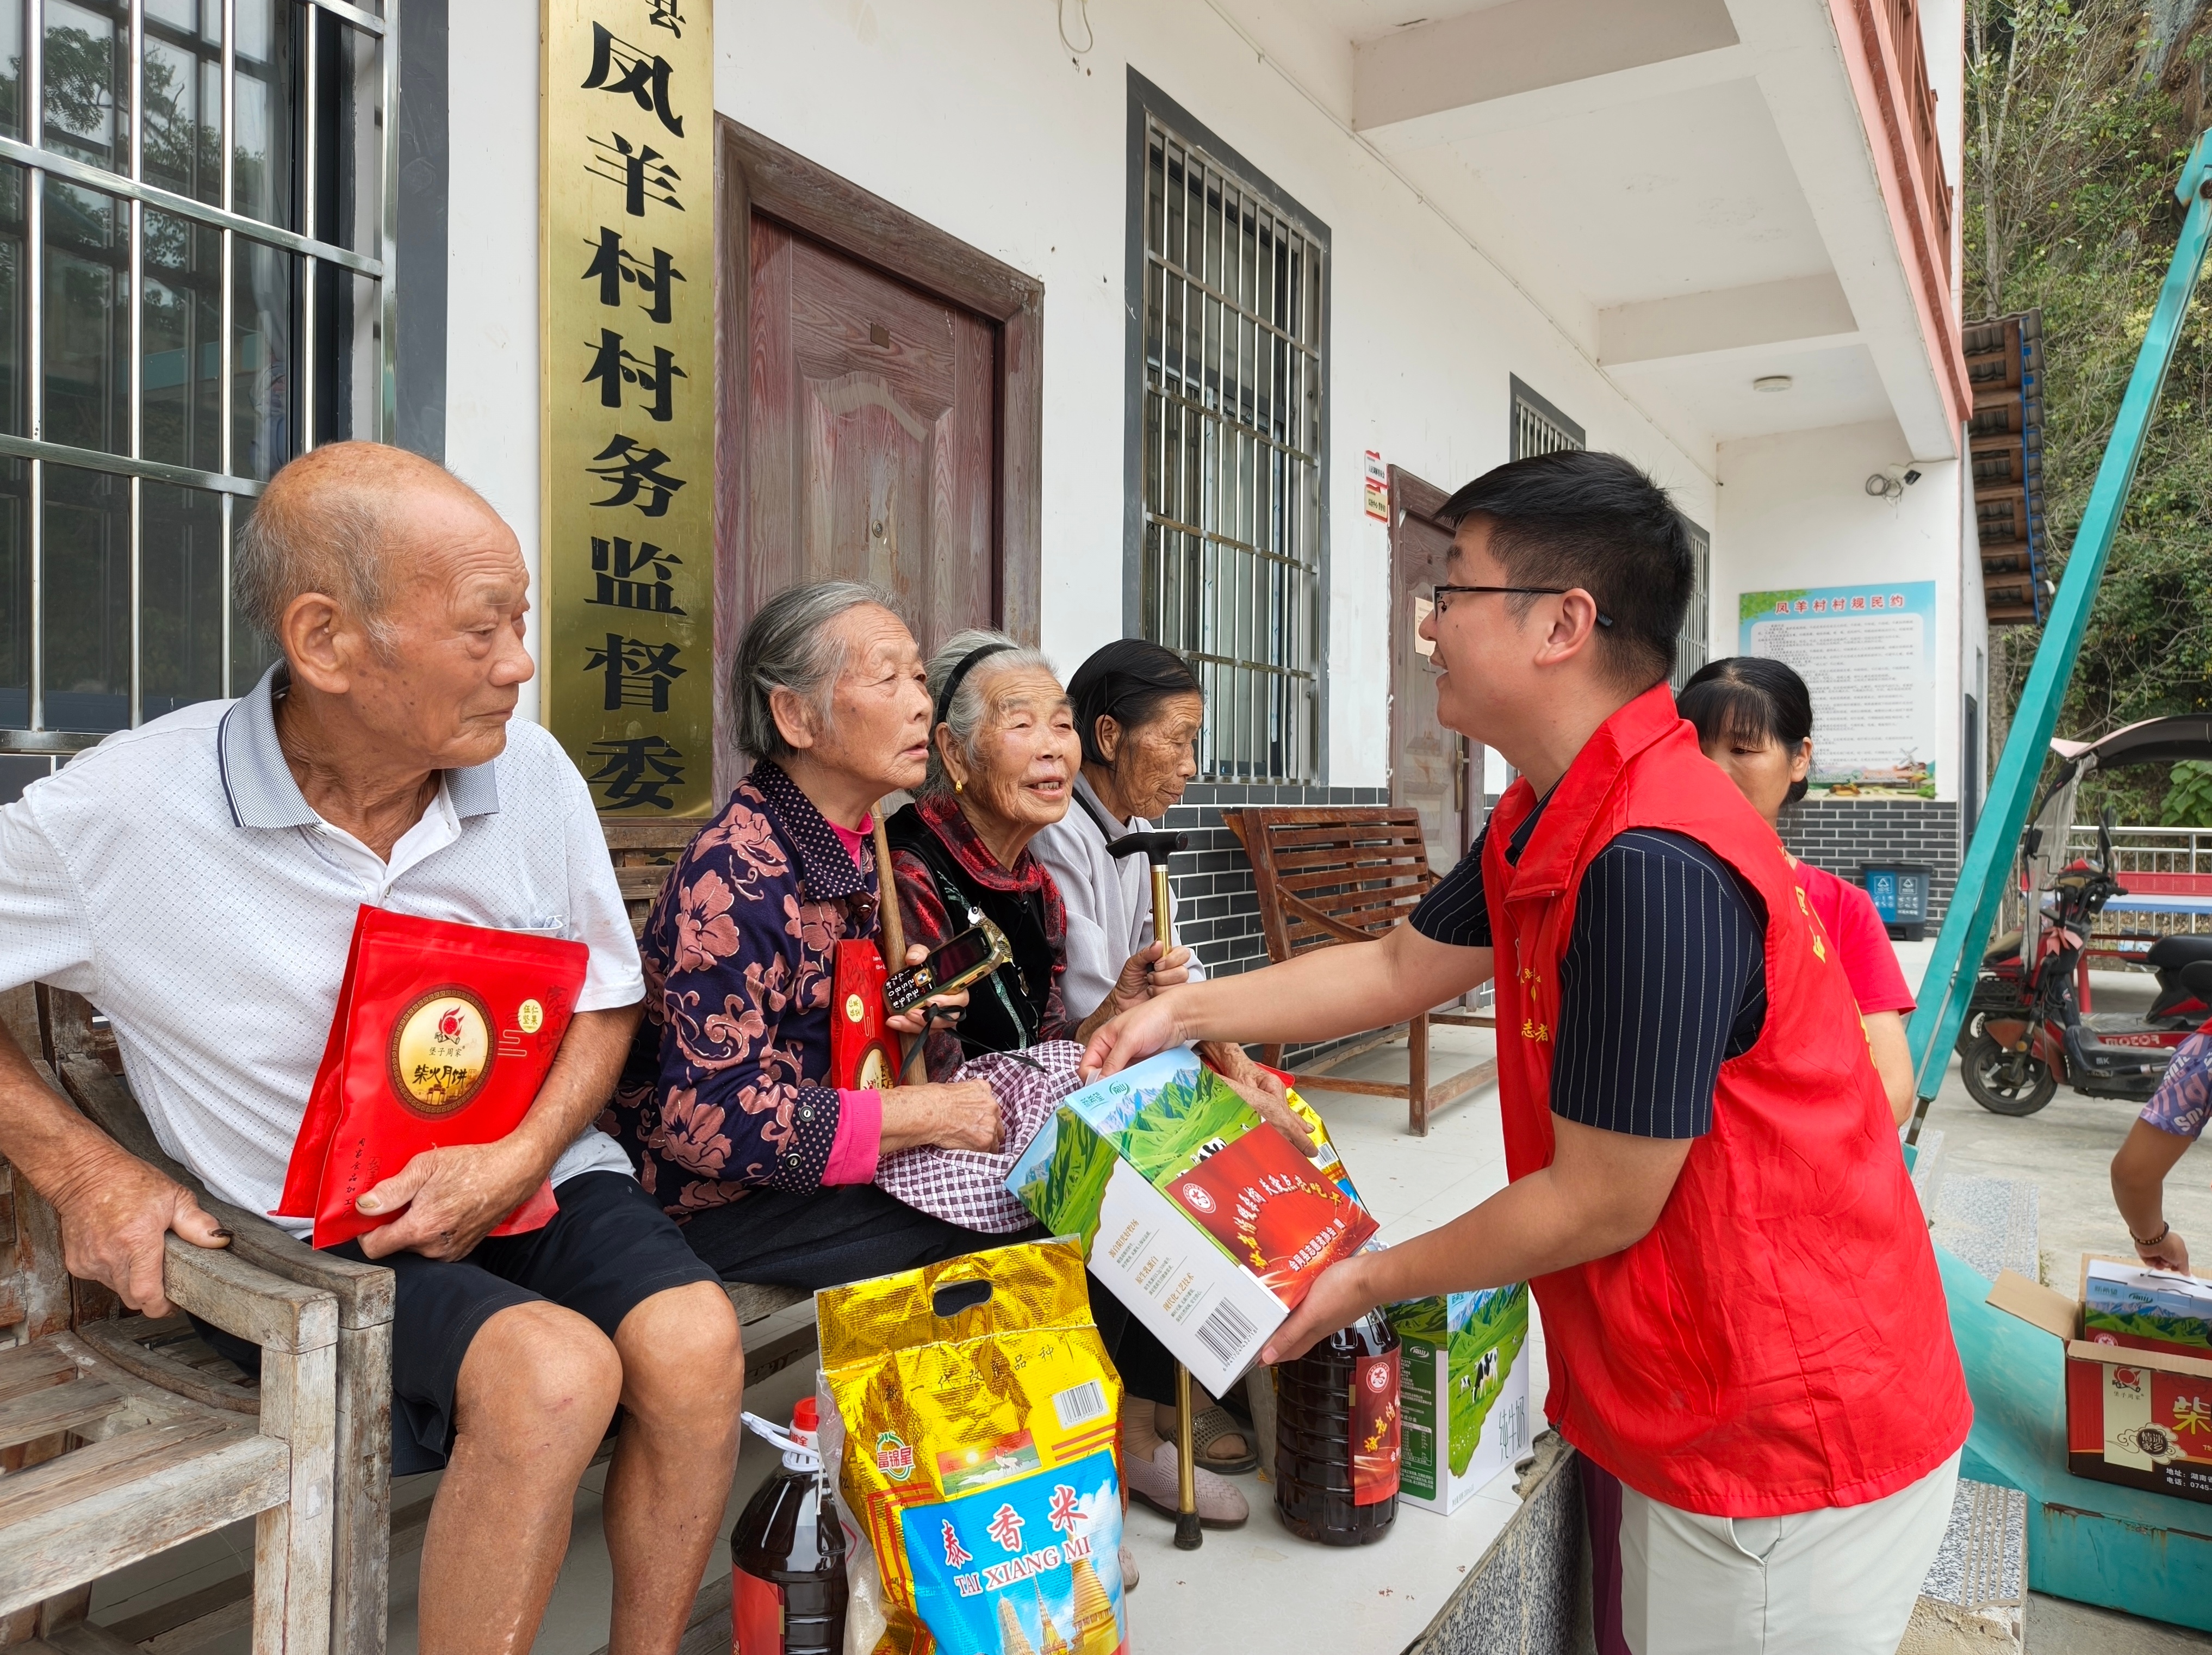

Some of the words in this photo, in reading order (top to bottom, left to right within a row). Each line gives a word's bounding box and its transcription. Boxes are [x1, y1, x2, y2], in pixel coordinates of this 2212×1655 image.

[1776, 594, 1904, 614] 凤羊村村规民约
[523, 1005, 539, 1014] 伍仁
[523, 1015, 538, 1025] 坚果
[429, 1047, 462, 1057] 堡子周家
[412, 1064, 468, 1089] 柴火月饼
[1108, 1218, 1139, 1257] 源自阳光好牧场
[1288, 1224, 1338, 1272] 会同县志愿者协会
[1134, 1255, 1159, 1284] 原生乳蛋白
[1162, 1272, 1194, 1311] 现代化工艺技术
[1499, 1396, 1526, 1464] 纯牛奶
[943, 1486, 1089, 1567] 泰香米
[955, 1574, 981, 1595] TAI
[985, 1548, 1059, 1589] XIANG
[1064, 1536, 1091, 1560] MI
